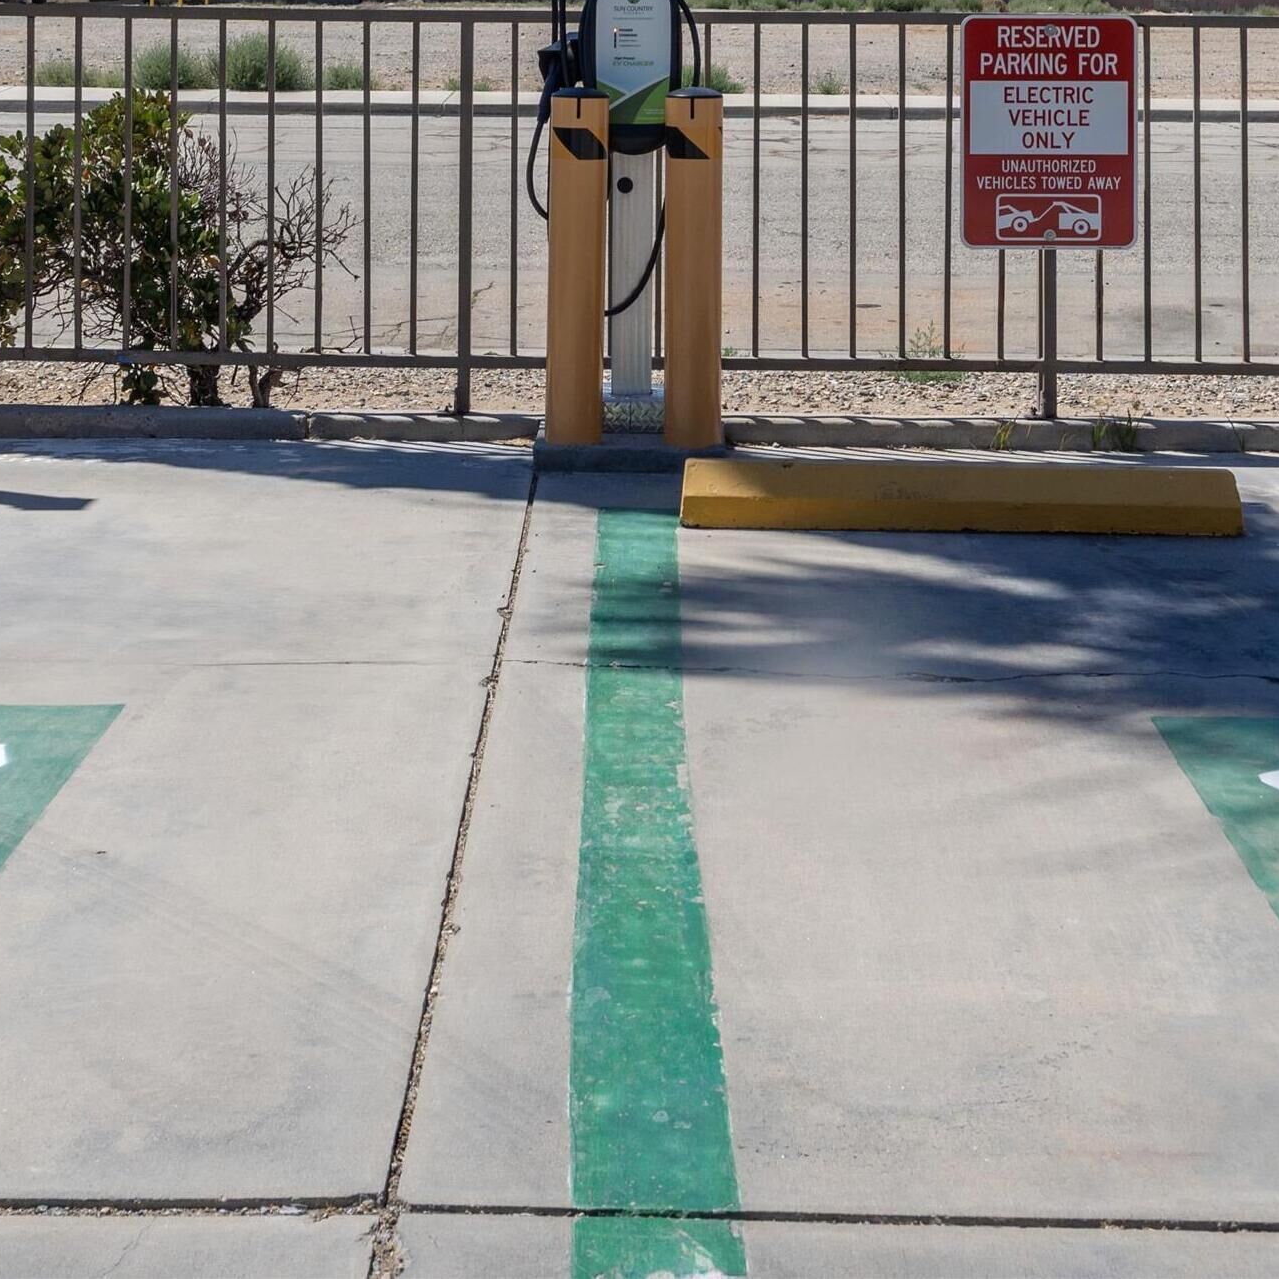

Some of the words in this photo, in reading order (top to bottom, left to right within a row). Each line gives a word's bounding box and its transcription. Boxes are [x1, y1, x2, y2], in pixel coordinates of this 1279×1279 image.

[997, 26, 1100, 48] RESERVED
[980, 53, 1067, 75] PARKING
[1078, 53, 1117, 75] FOR
[1004, 87, 1094, 104] ELECTRIC
[1009, 109, 1090, 126] VEHICLE
[1022, 132, 1075, 149] ONLY
[1001, 160, 1096, 173] UNAUTHORIZED
[976, 176, 1036, 190] VEHICLES
[1041, 176, 1082, 190] TOWED
[1088, 176, 1121, 190] AWAY
